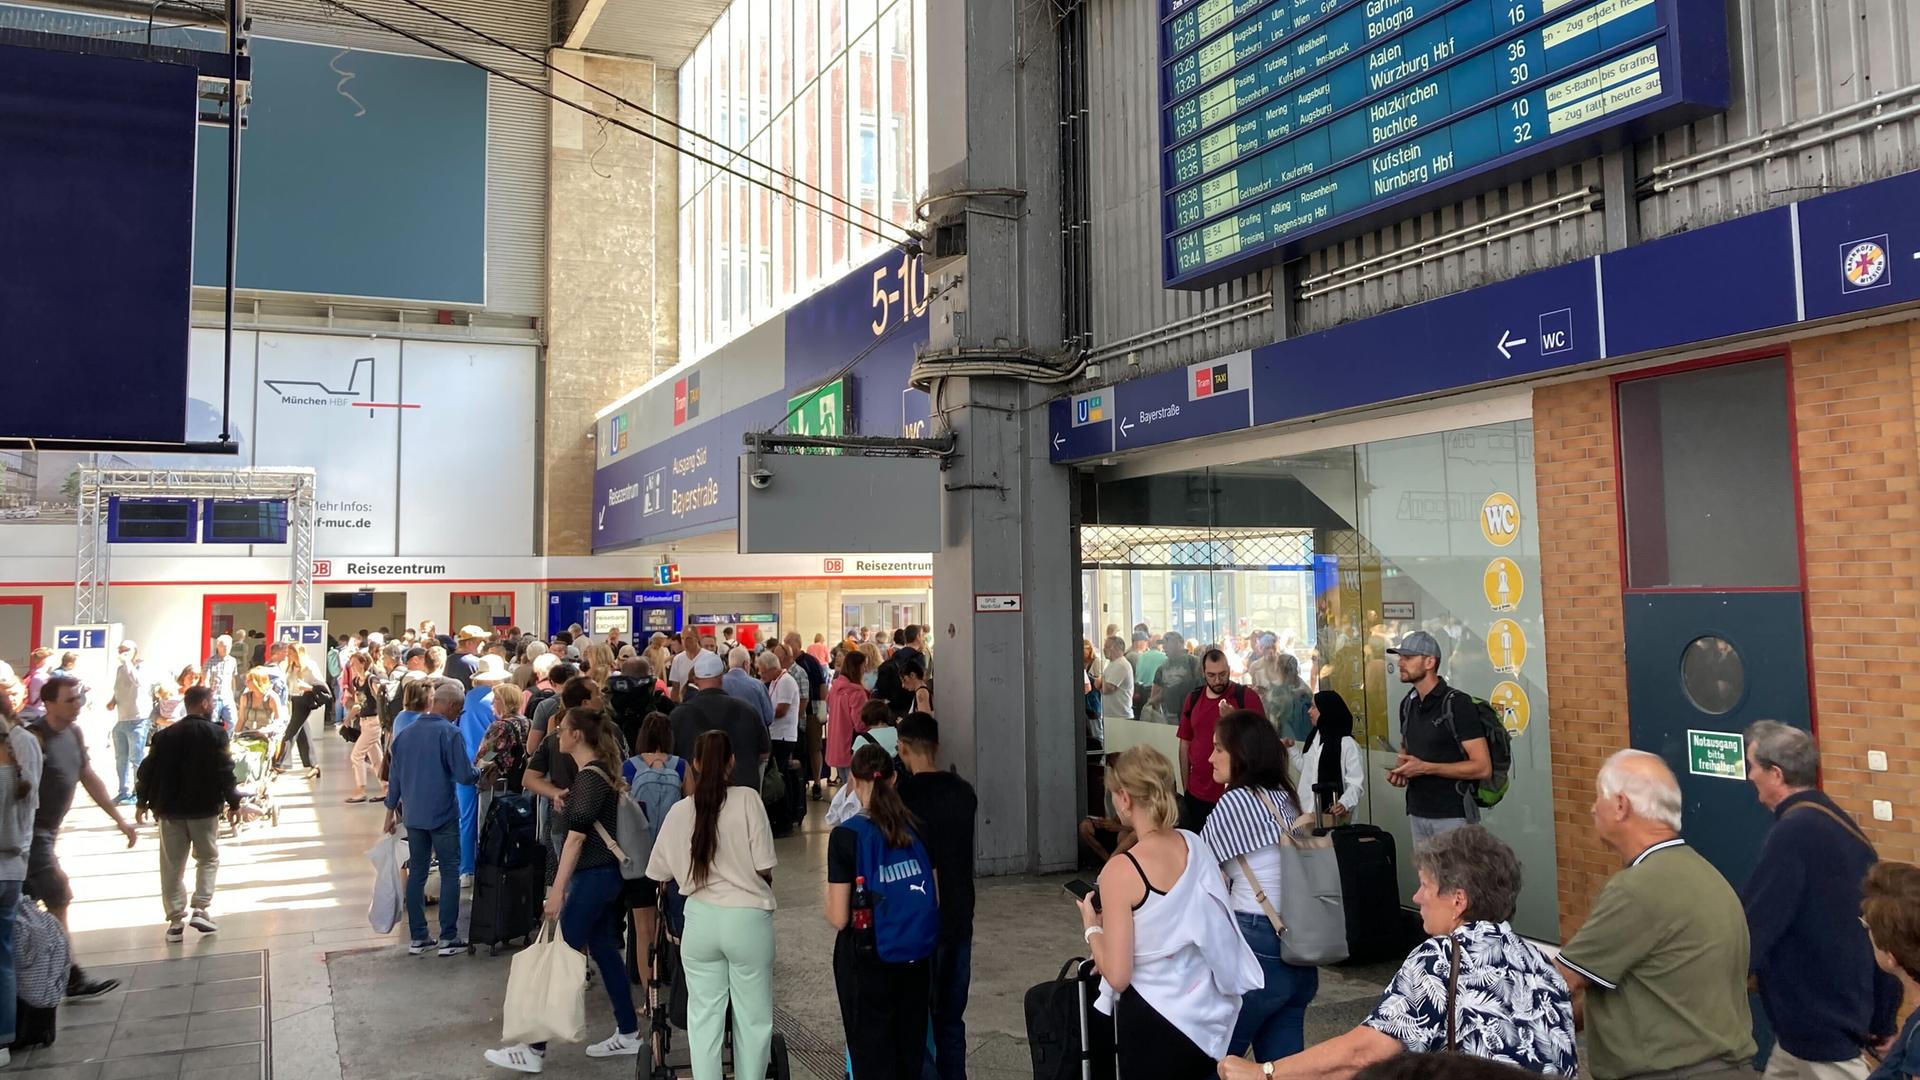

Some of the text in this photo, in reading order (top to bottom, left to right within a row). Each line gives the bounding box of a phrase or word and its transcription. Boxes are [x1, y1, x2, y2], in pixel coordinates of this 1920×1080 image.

[1173, 12, 1193, 34] 12:18
[1174, 30, 1195, 51] 12:28
[1174, 56, 1194, 77] 13:28
[1234, 22, 1262, 44] Augsburg
[1272, 8, 1284, 21] Ulm
[1175, 74, 1196, 94] 13:29
[1236, 42, 1262, 62] Salzburg
[1271, 28, 1283, 42] Linz
[1294, 14, 1310, 28] Wien
[1176, 118, 1197, 138] 13:34
[1236, 86, 1269, 108] Rosenheim
[1278, 66, 1305, 86] Kufstein
[1316, 42, 1350, 66] Innsbruck
[1368, 6, 1414, 39] Bologna
[1175, 100, 1196, 120] 13:32
[1236, 73, 1255, 89] Pasing
[1264, 56, 1287, 73] Tutzing
[1177, 161, 1198, 181] 13:35
[1238, 139, 1258, 154] Pasing
[1268, 124, 1289, 140] Mering
[1300, 103, 1332, 125] Augsburg
[1371, 53, 1428, 90] Würzburg
[1434, 37, 1454, 62] Hbf
[1508, 4, 1525, 26] 16
[1176, 144, 1197, 164] 13:35
[1236, 120, 1256, 135] Pasing
[1266, 105, 1288, 121] Mering
[1298, 83, 1330, 105] Augsburg
[1370, 44, 1401, 70] Aalen
[1177, 188, 1198, 208] 13:38
[1371, 82, 1438, 122] Holzkirchen
[1508, 40, 1525, 62] 36
[1566, 19, 1583, 32] Zug
[1587, 3, 1616, 23] endet
[1178, 206, 1199, 225] 13:40
[1240, 178, 1272, 200] Geltendorf
[1282, 163, 1313, 182] Kaufering
[1373, 114, 1417, 143] Buchloe
[1510, 63, 1528, 85] 30
[1179, 232, 1199, 252] 13:41
[1240, 213, 1260, 228] Grafing
[1301, 182, 1338, 203] Rosenheim
[1373, 144, 1421, 174] Kufstein
[1512, 99, 1529, 119] 10
[1548, 89, 1562, 101] die
[1565, 75, 1598, 95] S-Bahn
[1602, 69, 1615, 81] bis
[1619, 53, 1655, 73] Grafing
[1180, 250, 1200, 269] 13:44
[1241, 231, 1264, 246] Freising
[1274, 212, 1312, 234] Regensburg
[1315, 204, 1327, 219] Hbf
[1375, 164, 1428, 196] Nürnberg
[1433, 152, 1454, 174] Hbf
[1513, 123, 1532, 144] 32
[1565, 108, 1582, 121] Zug
[1611, 85, 1641, 104] heute
[1861, 261, 1882, 282] MISSION
[872, 254, 928, 336] 5-10
[1542, 330, 1565, 349] WC
[1215, 373, 1226, 383] TAXI
[282, 396, 348, 406] München HBF
[1079, 401, 1087, 421] U
[1140, 404, 1180, 423] Bayerstraße
[673, 445, 707, 476] Ausgang Süd
[341, 501, 372, 512] Infos:
[609, 483, 638, 507] Reisezentrum
[672, 477, 718, 519] Bayerstraße
[1485, 504, 1514, 535] WC
[347, 562, 445, 574] Reisezentrum
[827, 561, 841, 570] DB
[1694, 734, 1738, 752] Notausgang
[1707, 750, 1725, 760] bitte
[1698, 759, 1735, 773] freihalten
